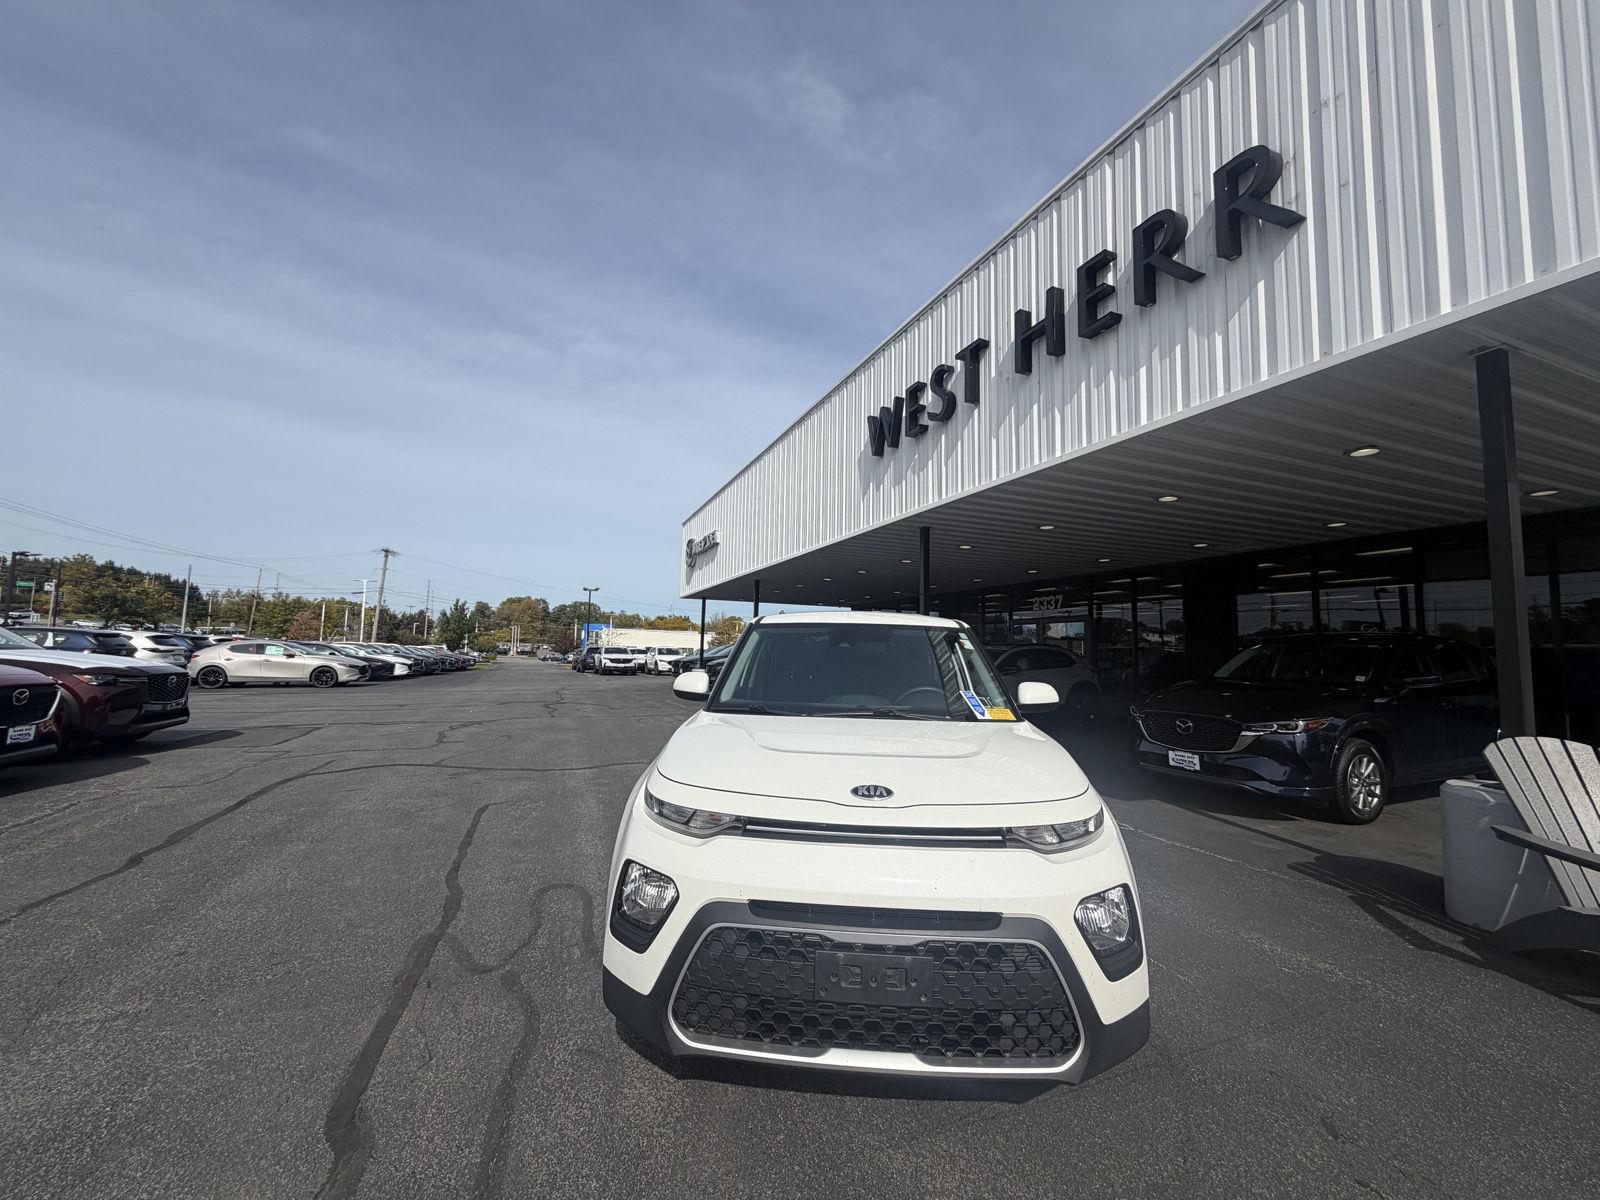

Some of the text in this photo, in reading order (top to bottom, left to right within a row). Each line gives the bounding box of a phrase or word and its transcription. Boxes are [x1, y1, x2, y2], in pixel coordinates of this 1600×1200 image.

[867, 144, 1307, 457] WEST HERR
[1033, 595, 1063, 610] 2337
[857, 785, 888, 796] KIA
